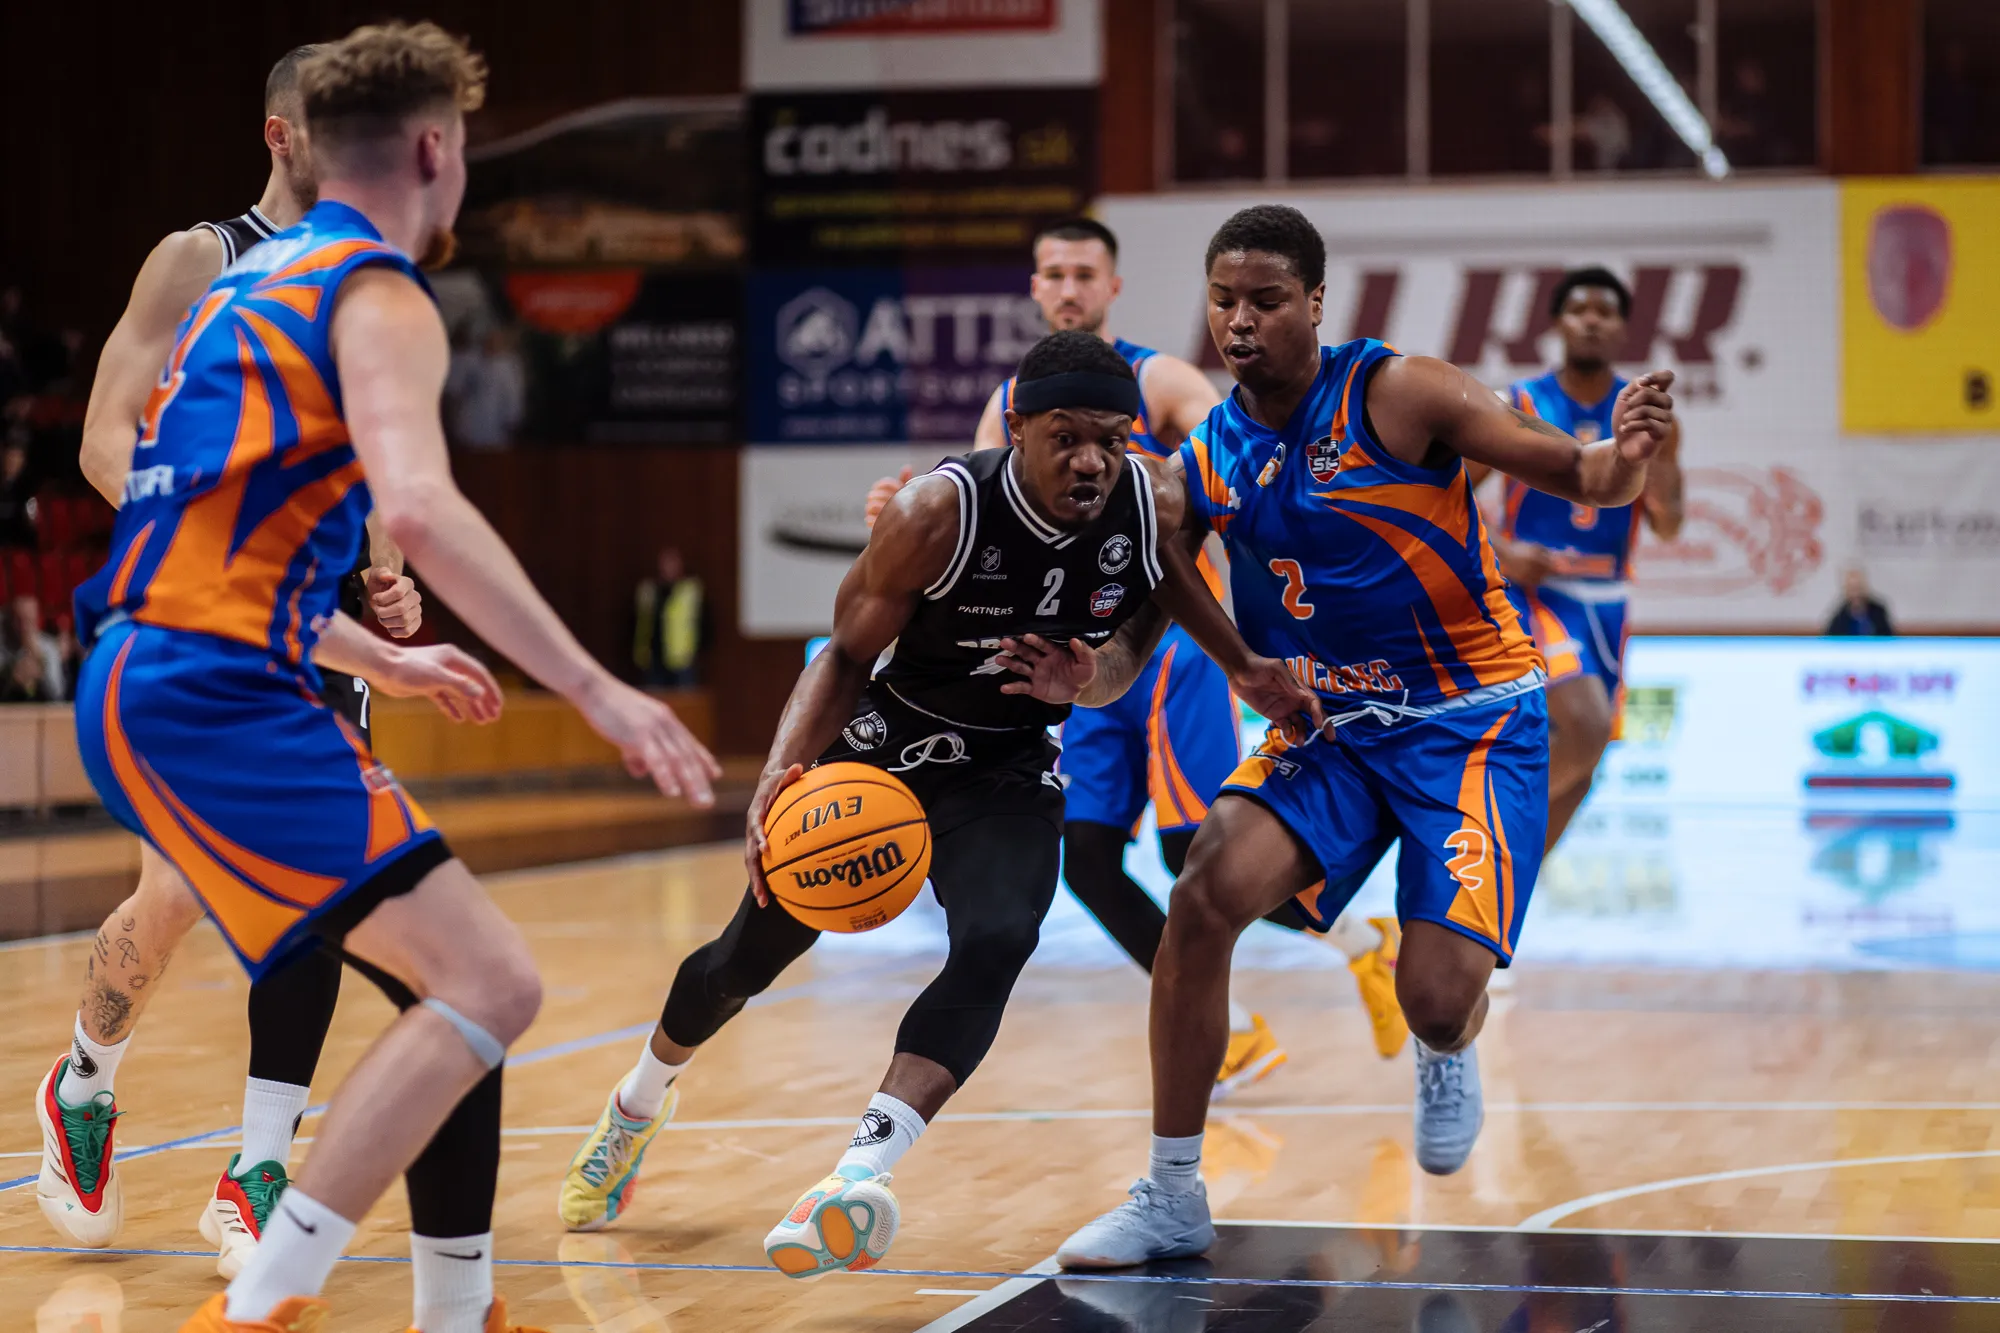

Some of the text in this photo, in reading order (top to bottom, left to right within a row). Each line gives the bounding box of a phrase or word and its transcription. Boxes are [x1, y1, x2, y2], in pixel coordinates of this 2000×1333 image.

[958, 605, 1014, 616] PARTNERS
[1035, 568, 1065, 616] 2
[1093, 598, 1117, 611] SBL
[1101, 588, 1125, 598] TIPOS
[1269, 558, 1314, 619] 2
[793, 840, 907, 890] Wilson
[1443, 829, 1487, 891] 2
